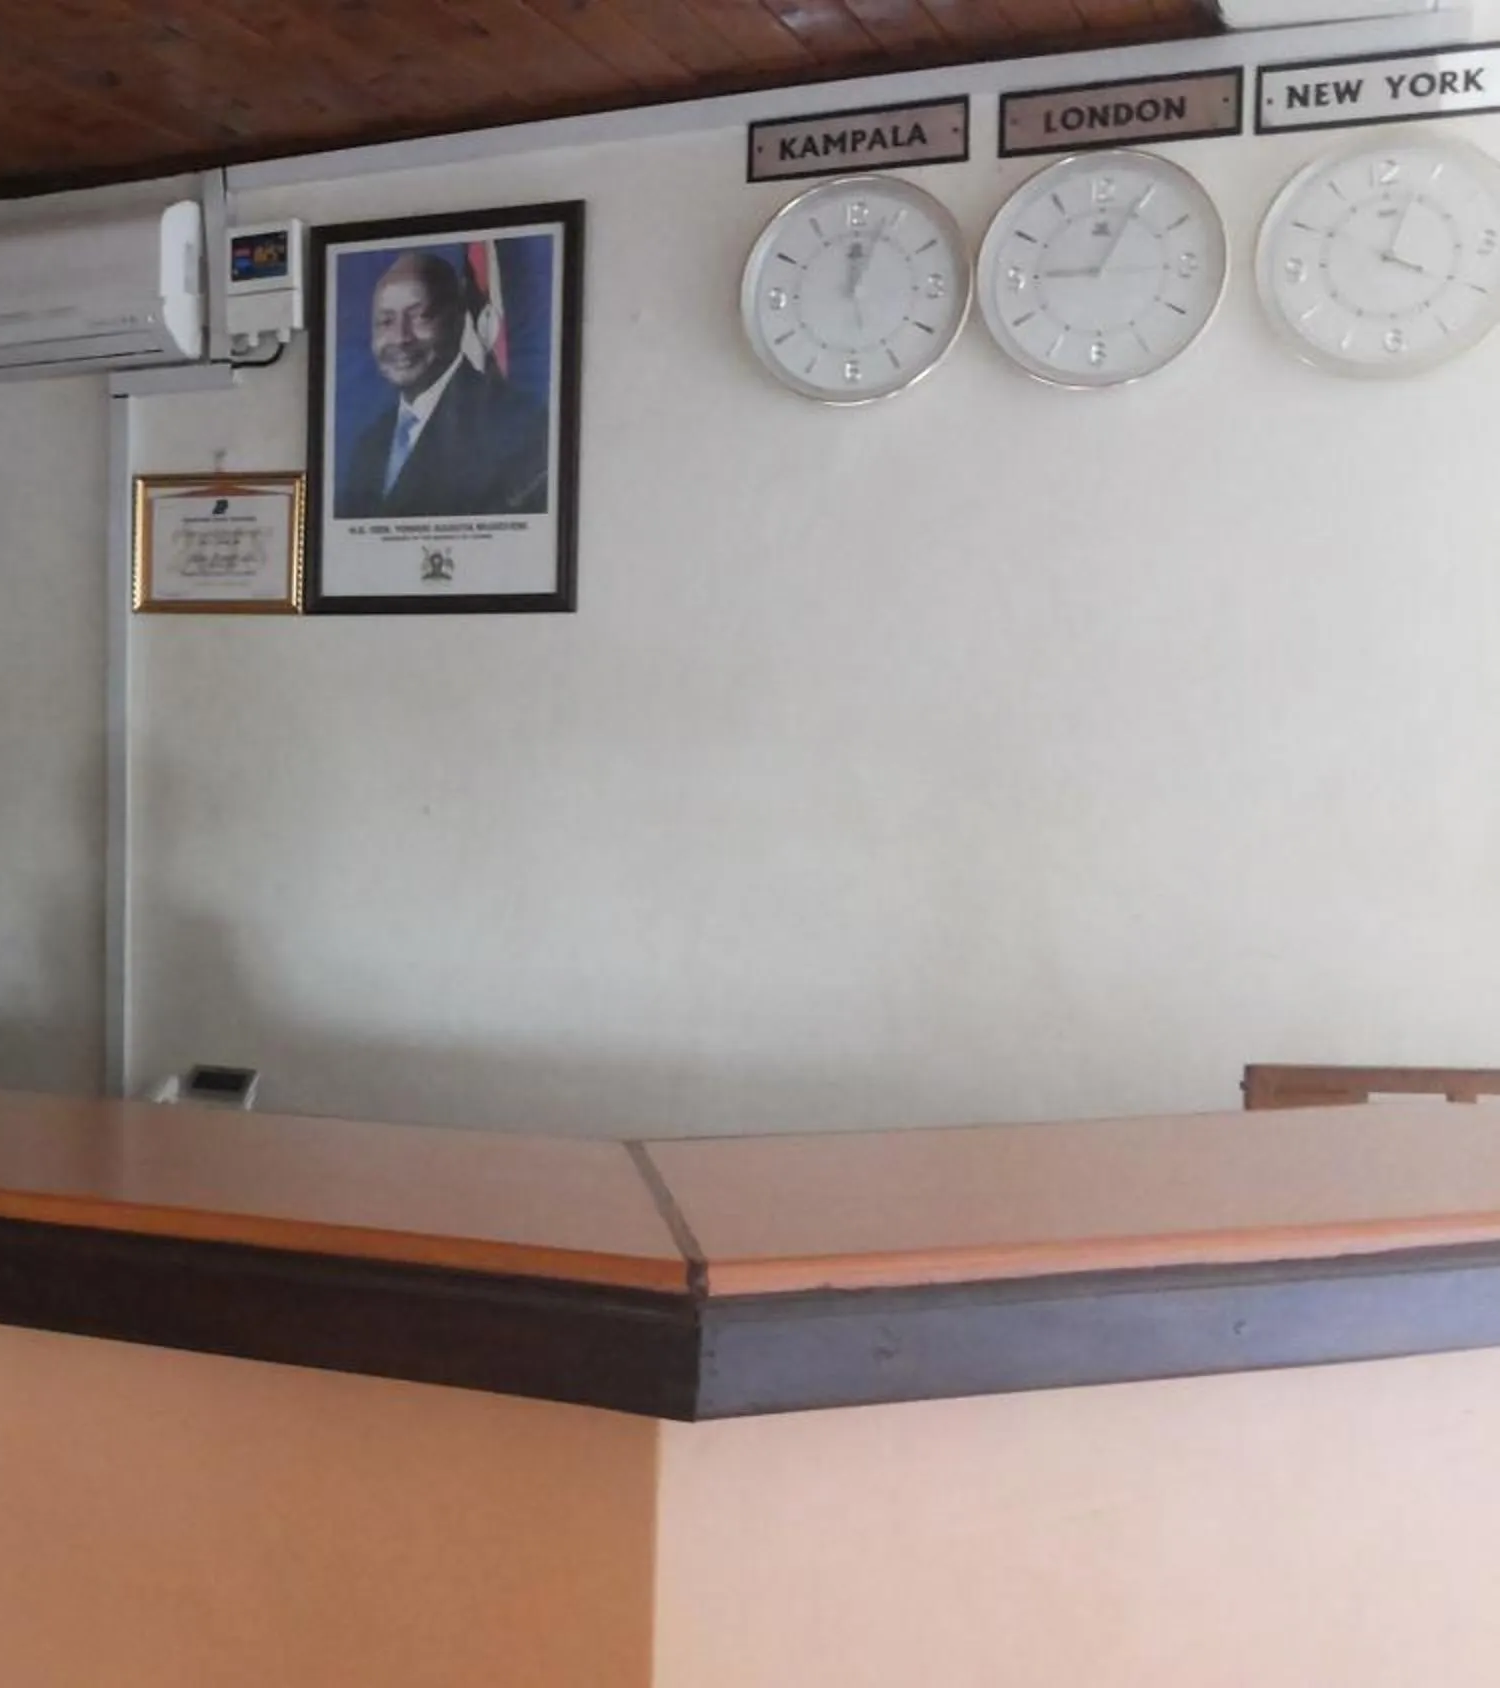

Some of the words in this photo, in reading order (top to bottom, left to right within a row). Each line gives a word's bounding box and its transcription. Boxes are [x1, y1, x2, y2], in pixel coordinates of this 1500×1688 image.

[1286, 79, 1363, 109] NEW
[1385, 67, 1484, 100] YORK
[1043, 96, 1187, 134] LONDON
[779, 122, 928, 161] KAMPALA
